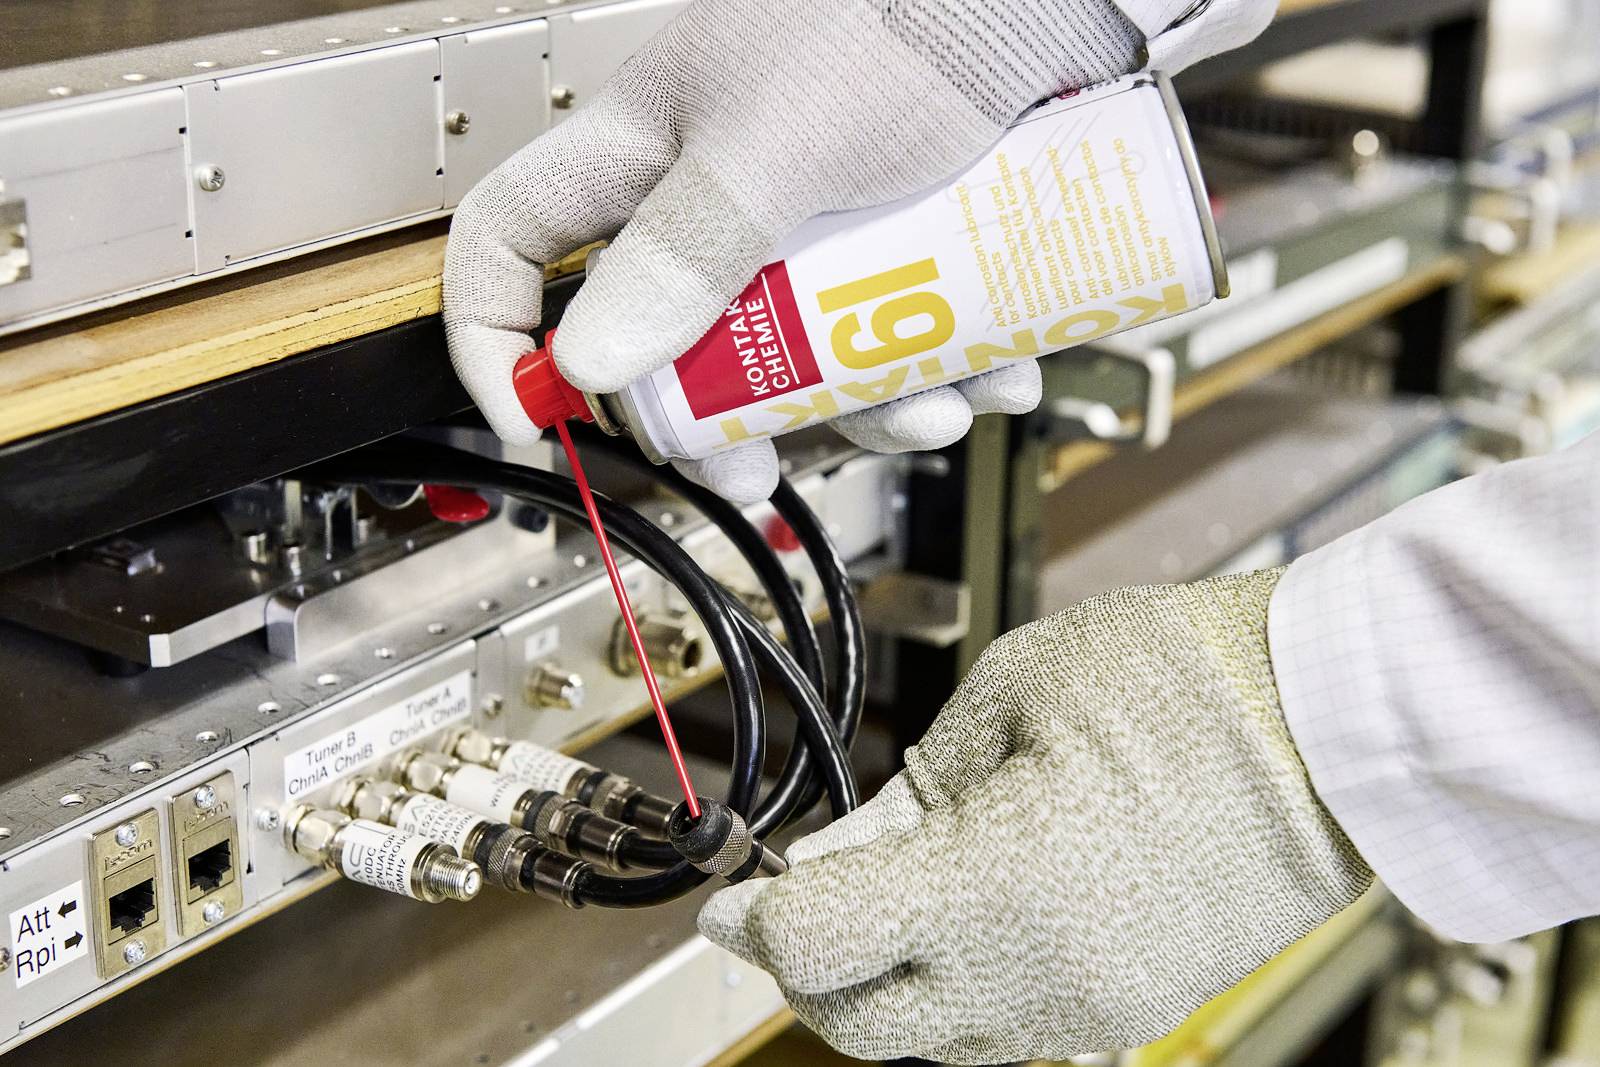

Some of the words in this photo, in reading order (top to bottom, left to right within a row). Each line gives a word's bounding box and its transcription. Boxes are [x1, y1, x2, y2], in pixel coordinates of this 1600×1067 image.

[1081, 138, 1107, 205] contactos
[1113, 136, 1126, 155] do
[990, 185, 1006, 212] und
[996, 152, 1019, 206] Kontakte
[1119, 154, 1154, 249] antykorozyjny
[956, 182, 981, 244] lubricant
[1013, 207, 1026, 229] für
[1019, 166, 1052, 253] anticorrosion
[1072, 177, 1100, 248] contacten
[1099, 206, 1113, 225] de
[999, 213, 1038, 320] Korrosionsschutz
[1018, 228, 1052, 316] Schmiermittel
[1050, 218, 1075, 278] contacts
[1093, 250, 1107, 278] voor
[1106, 226, 1132, 292] Lubricante
[1115, 204, 1145, 287] anticorrosion
[1145, 249, 1163, 282] Smar
[975, 244, 1001, 306] corrosion
[992, 251, 1017, 308] contacts
[1043, 255, 1070, 311] Lubrifiant
[1067, 279, 1085, 305] pour
[1102, 279, 1114, 297] del
[816, 256, 956, 370] 61
[992, 306, 1008, 328] Anti
[1009, 313, 1022, 325] for
[725, 297, 771, 397] KONTAK
[746, 297, 791, 390] CHEMIE
[405, 696, 441, 719] Tuner
[444, 687, 452, 698] A
[305, 739, 343, 767] Tuner
[346, 731, 357, 749] B
[17, 906, 51, 943] Att
[15, 937, 56, 979] Rpi
